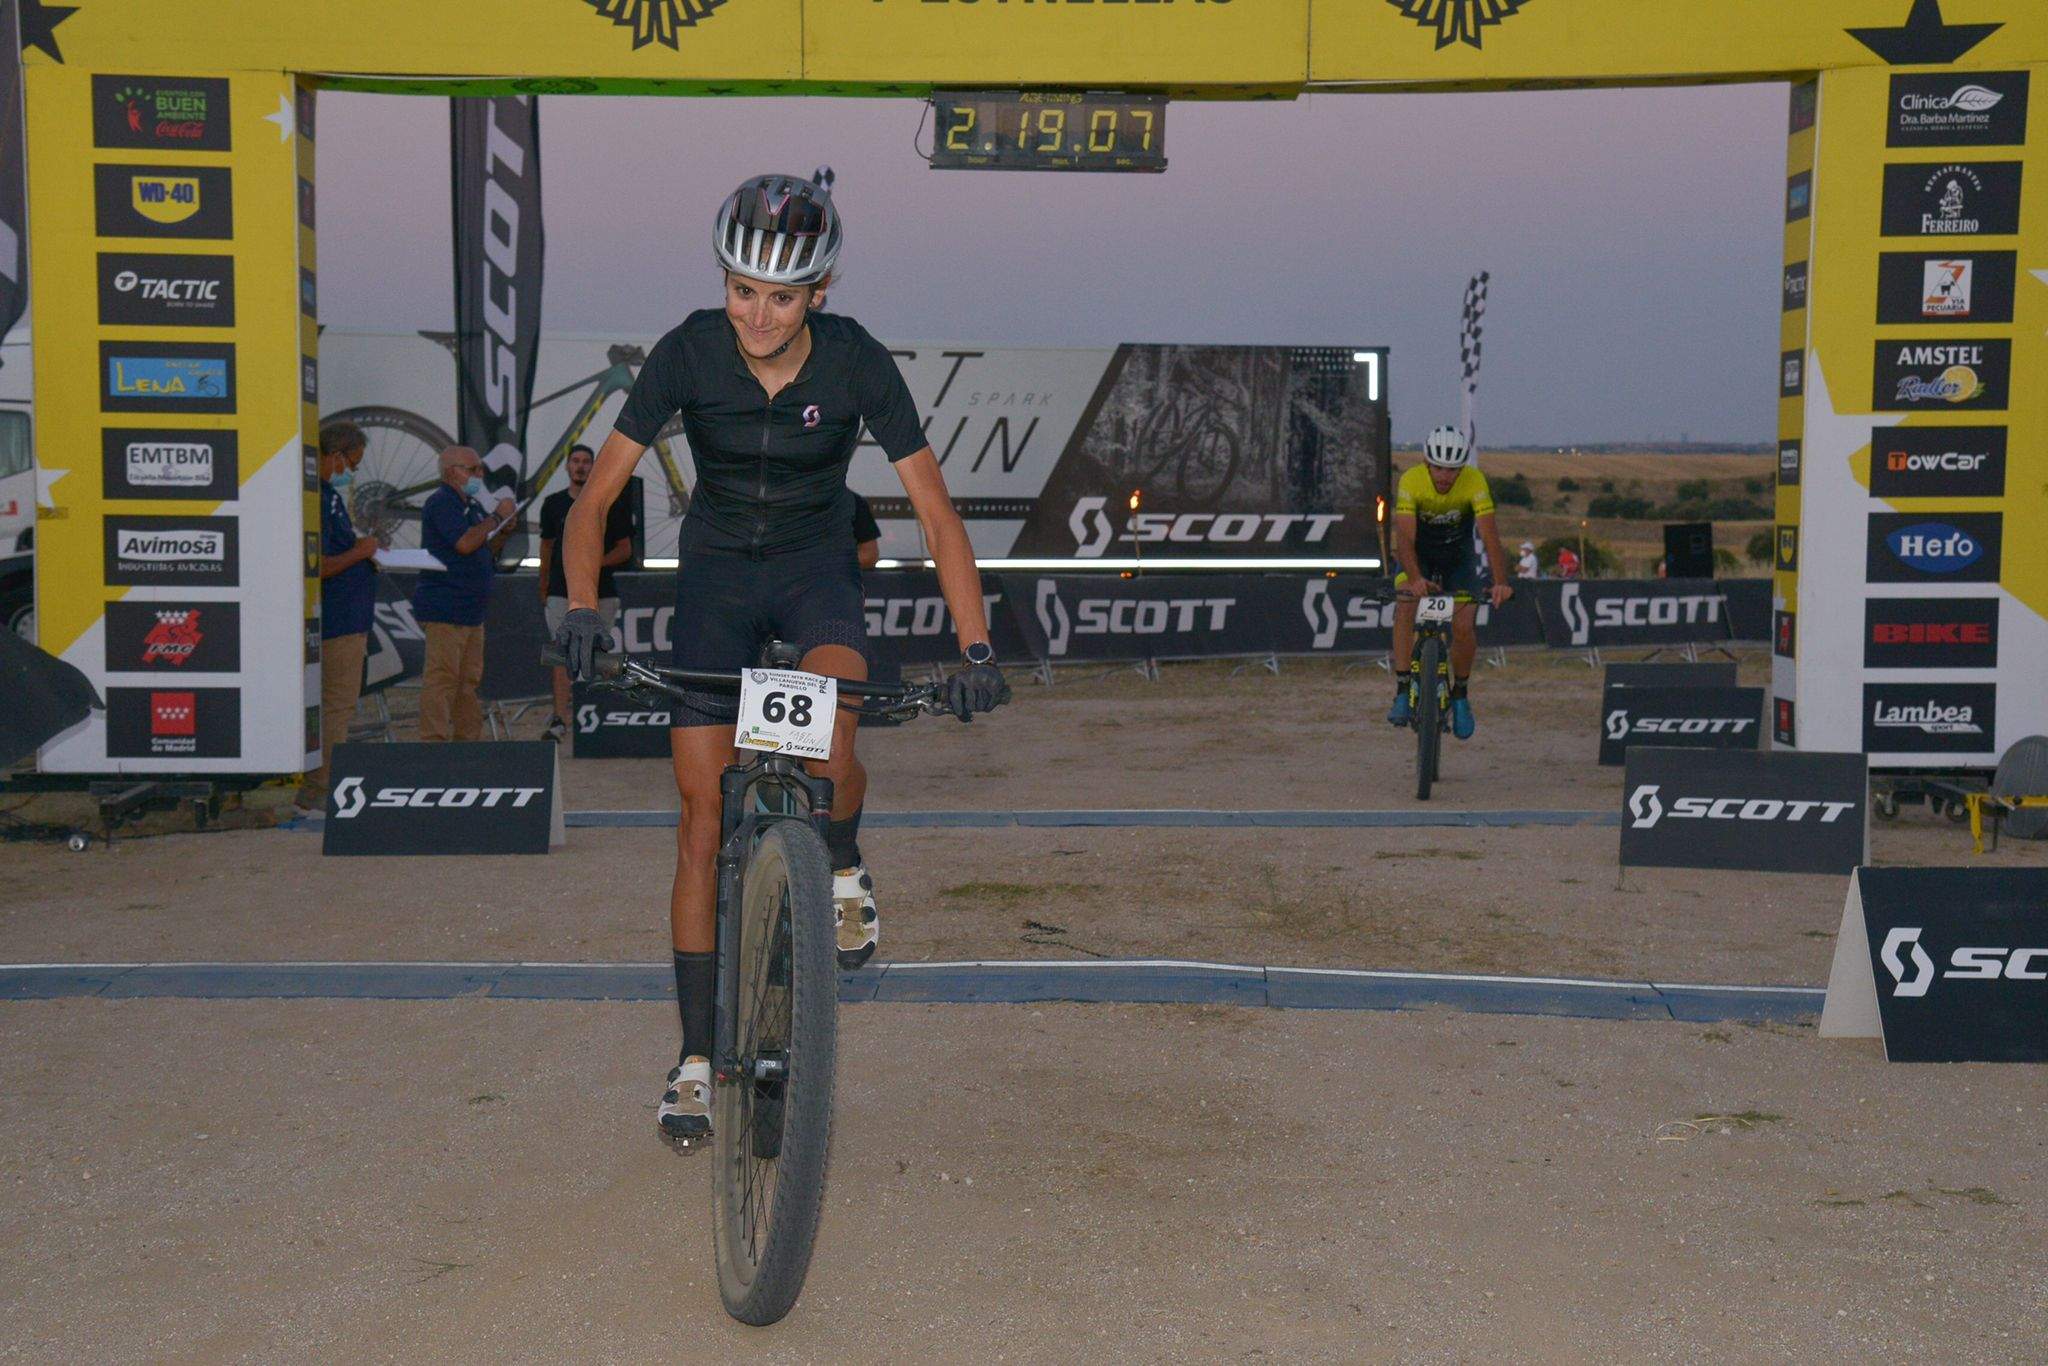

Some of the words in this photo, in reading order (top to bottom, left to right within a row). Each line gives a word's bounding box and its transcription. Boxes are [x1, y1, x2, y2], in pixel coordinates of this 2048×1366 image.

[156, 97, 207, 111] BUEN
[1900, 94, 1949, 110] Clínica
[157, 111, 206, 120] AMBIENTE
[1900, 114, 1919, 124] Dra.
[1920, 114, 1947, 124] Barba
[139, 182, 194, 203] WD-40
[1921, 213, 1979, 233] FERREIRO
[483, 95, 527, 432] SCOT
[140, 279, 220, 300] TACTIC
[1897, 346, 1983, 365] AMSTEL
[968, 393, 1053, 405] SPARK
[130, 447, 210, 464] EMTBM
[1888, 452, 1986, 471] TowCar
[1118, 514, 1344, 542] SCOTT
[122, 536, 217, 554] Avimosa
[1900, 532, 1974, 556] Hero
[1427, 599, 1446, 611] 20
[1594, 595, 1727, 627] SCOTT
[1075, 598, 1236, 634] SCOTT
[1873, 623, 1990, 643] BIKE
[763, 691, 813, 727] 68
[1874, 700, 1973, 722] Lambea
[1631, 718, 1755, 733] SCOTT
[369, 788, 544, 807] SCOTT
[1667, 798, 1856, 822] SCOTT
[1943, 948, 2048, 979] SC
